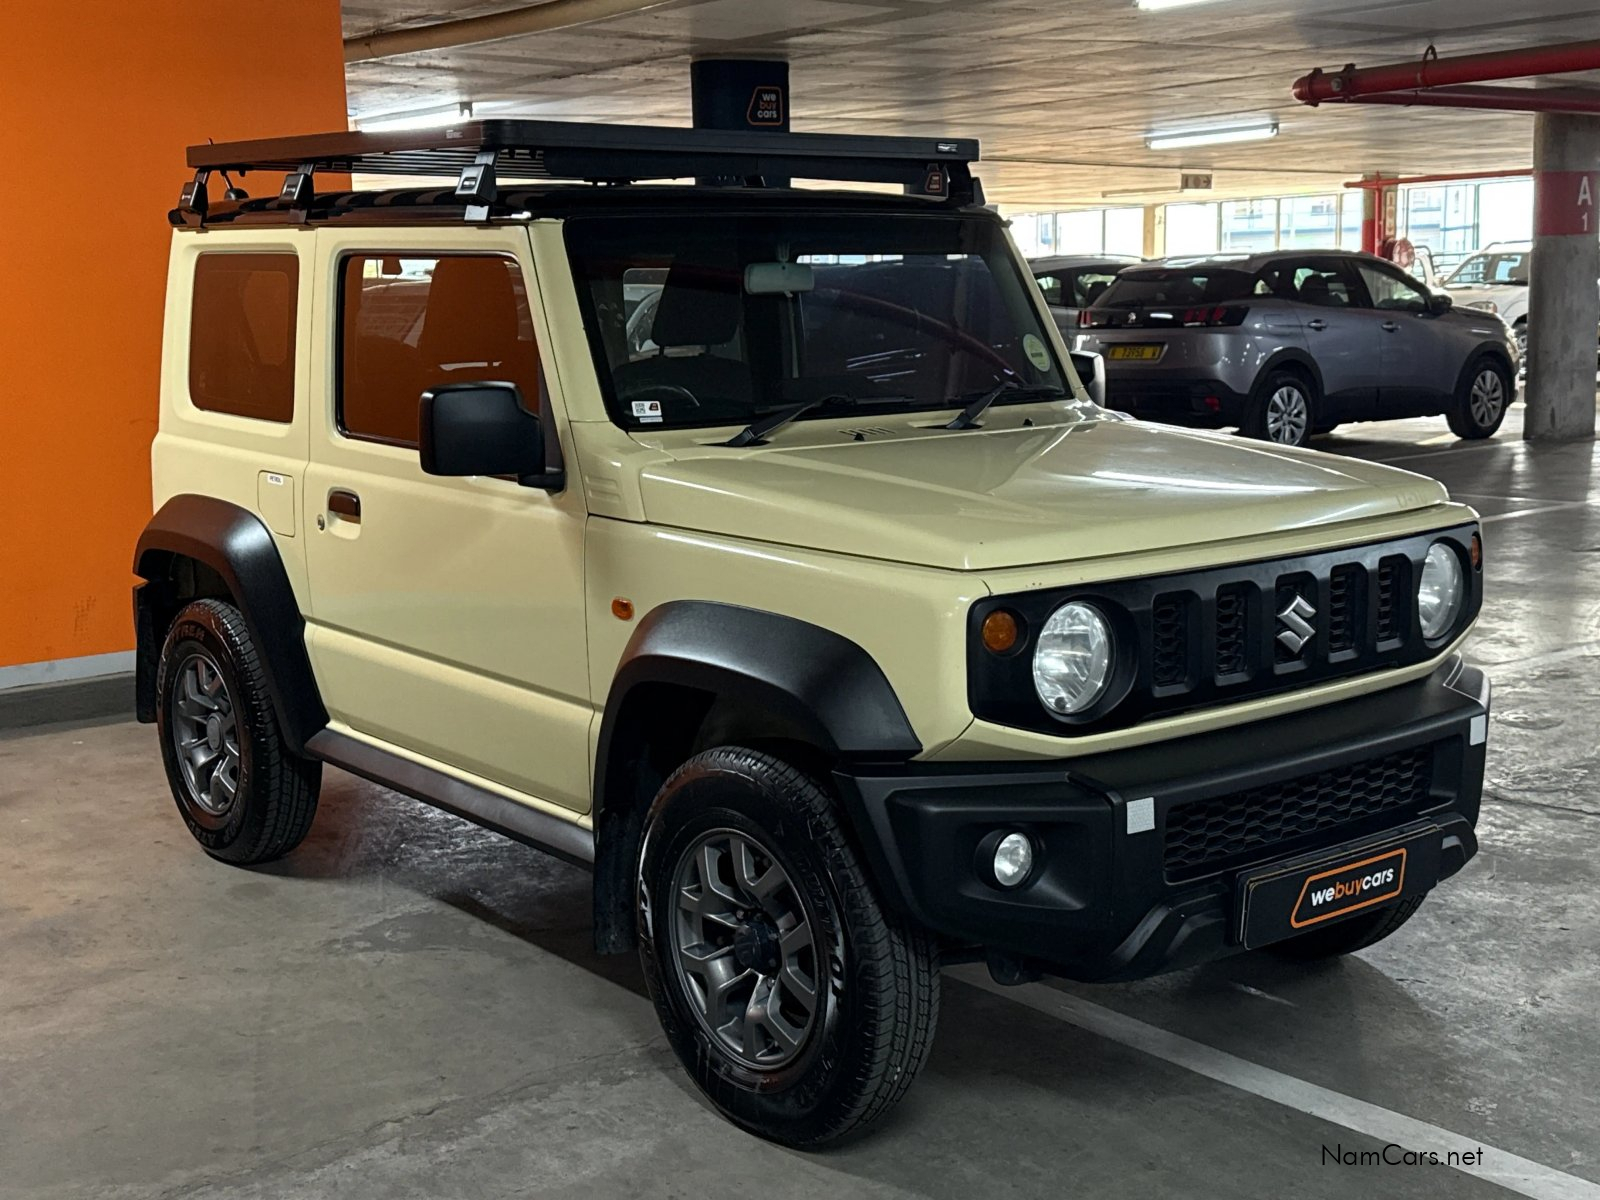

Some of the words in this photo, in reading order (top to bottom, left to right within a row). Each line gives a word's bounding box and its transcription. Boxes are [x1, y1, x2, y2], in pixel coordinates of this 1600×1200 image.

[762, 93, 777, 102] we
[760, 101, 777, 110] buy
[757, 110, 778, 119] cars
[1577, 175, 1593, 206] A
[1581, 211, 1588, 232] 1
[1311, 868, 1394, 906] webuycars
